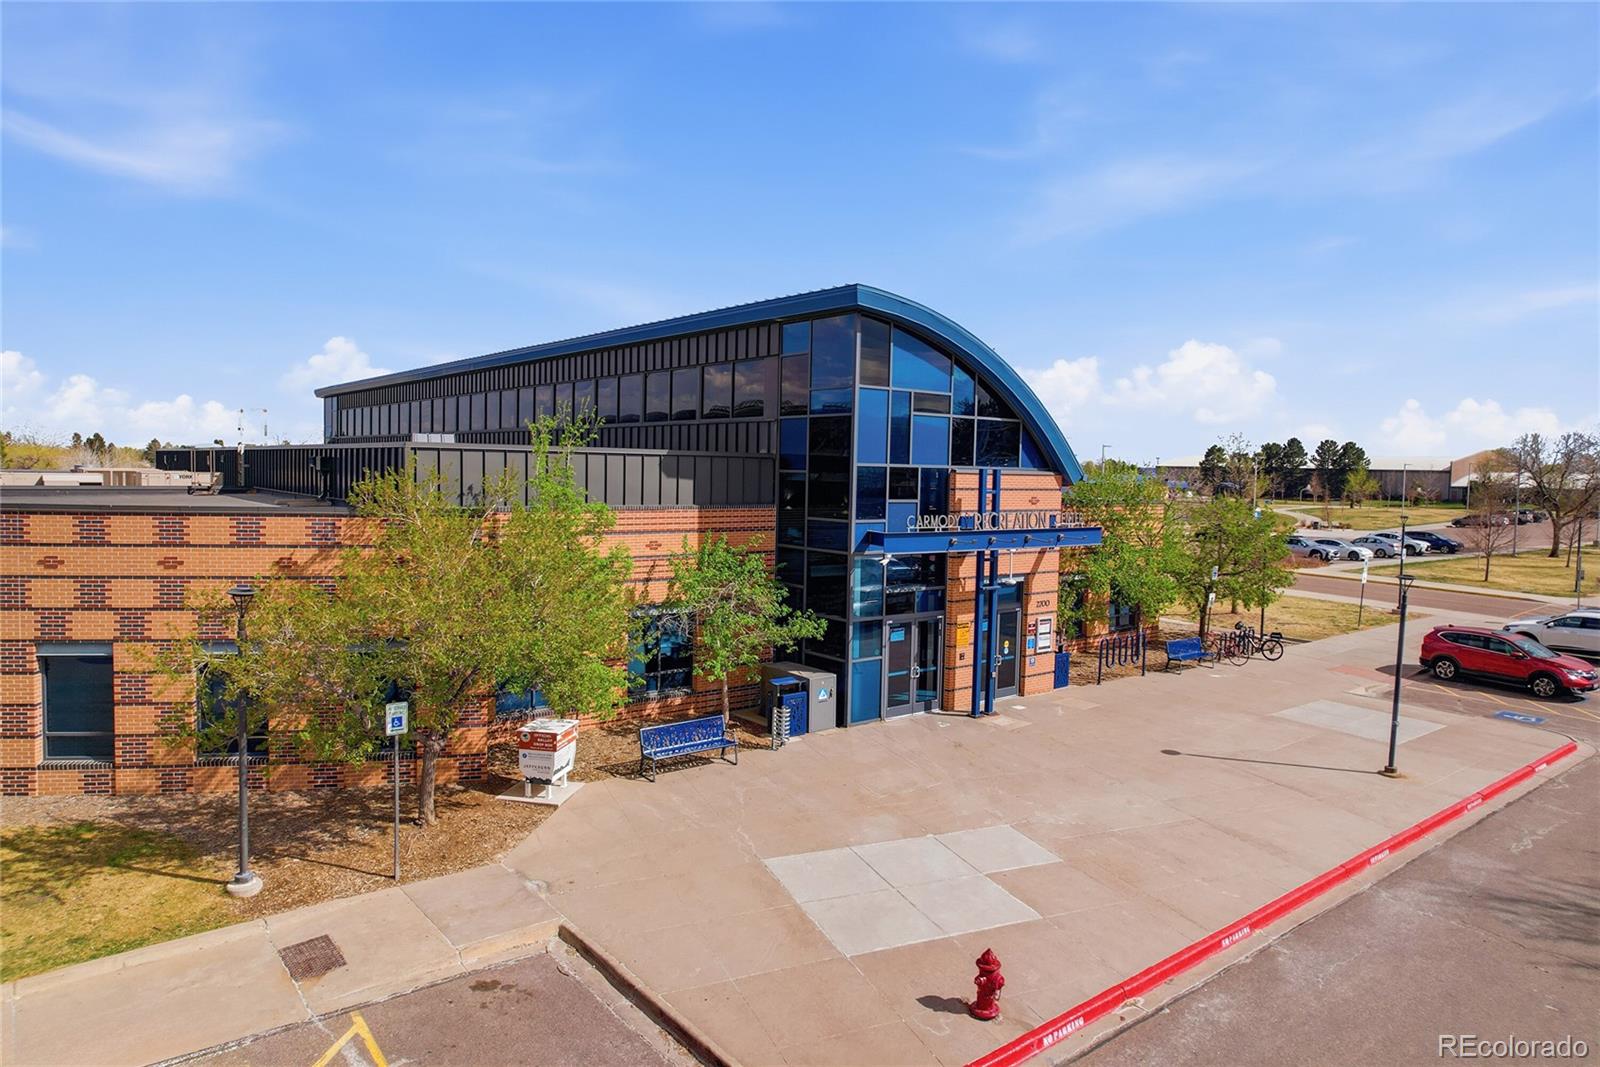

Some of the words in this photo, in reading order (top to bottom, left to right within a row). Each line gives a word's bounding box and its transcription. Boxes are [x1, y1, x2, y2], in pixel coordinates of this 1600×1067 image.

[906, 514, 960, 528] CARMODY
[974, 510, 1046, 530] RECREATION
[1056, 511, 1084, 524] CENTER
[1036, 599, 1051, 608] 2200
[1042, 1033, 1053, 1047] NO
[1052, 1016, 1084, 1041] PARKING
